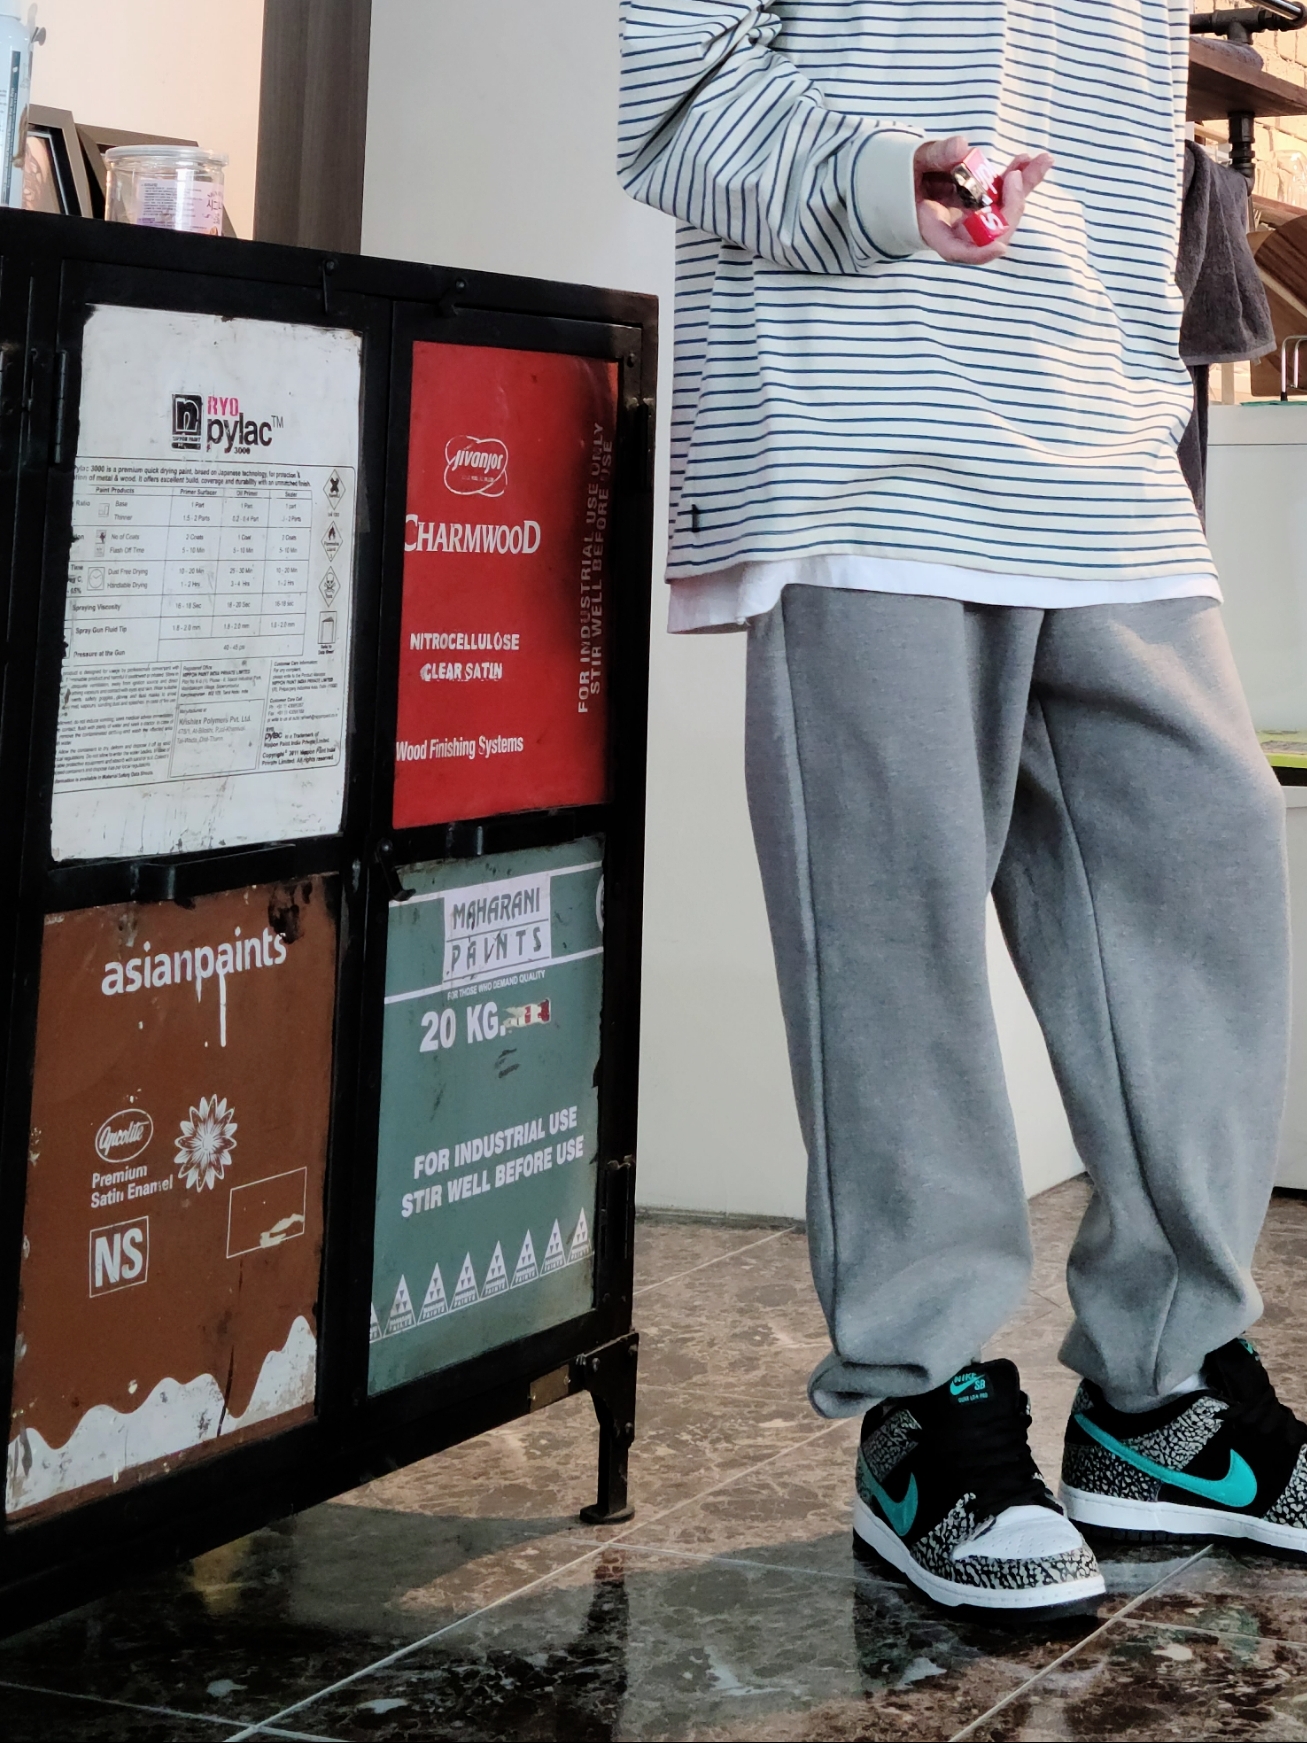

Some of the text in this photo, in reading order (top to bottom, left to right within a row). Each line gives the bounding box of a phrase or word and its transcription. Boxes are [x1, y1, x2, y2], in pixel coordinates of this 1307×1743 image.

[207, 396, 239, 416] RYO
[207, 412, 284, 453] pylac TM
[160, 467, 177, 475] drying
[218, 469, 241, 477] Japanese
[586, 483, 599, 524] USE
[404, 514, 541, 554] CHARMWOOD
[592, 488, 609, 571] BEFORE
[132, 568, 148, 576] Drying
[72, 603, 121, 612] Spraying Viscosity
[580, 532, 594, 662] INDUSTRIAL
[591, 579, 603, 637] WELL
[75, 627, 91, 635] Spray
[410, 632, 520, 650] NITROCELLULOSE
[420, 662, 503, 681] CLEAR SATIN
[591, 646, 602, 694] STIR
[578, 671, 590, 713] FOR
[396, 735, 523, 761] Wood Finishing Systems
[453, 887, 540, 930] MAHARANI
[101, 926, 287, 998] asianpaints
[451, 927, 542, 972] PAINTS
[447, 970, 546, 1001] FOR THOSE WHO DEMAND QUALITY
[420, 1002, 506, 1052] 20 KG.
[414, 1106, 578, 1179] FOR INDUSTRIAL USE
[91, 1174, 173, 1208] Satin Enamel
[92, 1165, 148, 1189] Premium
[401, 1135, 584, 1218] STIR WELL BEFORE USE
[95, 1228, 143, 1288] NS
[974, 1379, 986, 1391] SB
